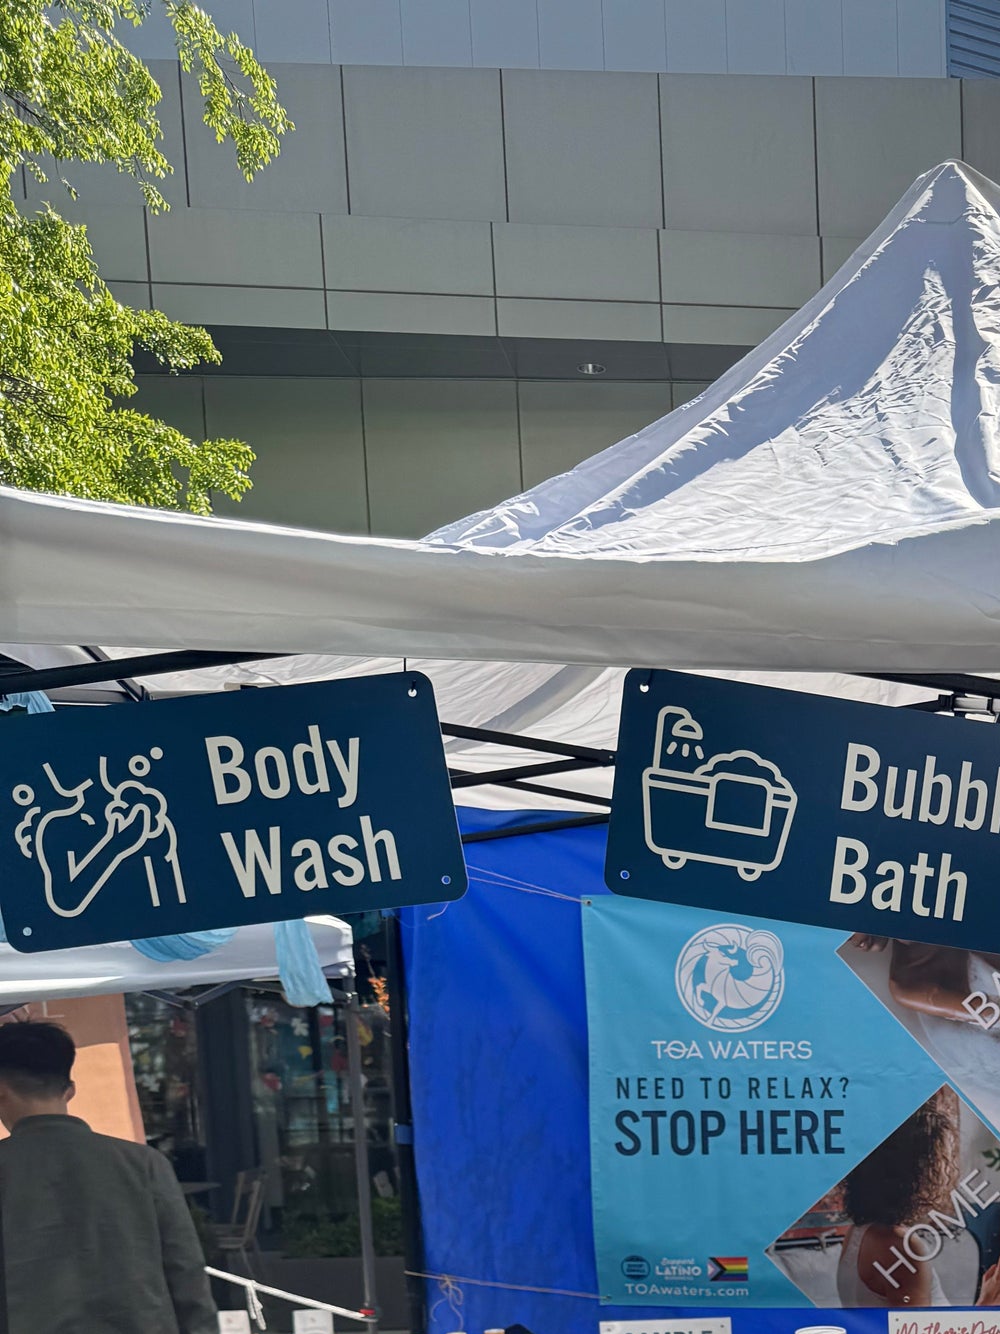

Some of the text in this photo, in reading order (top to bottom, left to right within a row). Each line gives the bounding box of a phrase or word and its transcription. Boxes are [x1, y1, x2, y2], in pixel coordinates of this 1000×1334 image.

[206, 725, 359, 807] Body
[221, 816, 402, 898] Wash
[830, 837, 968, 922] Bath
[651, 1041, 812, 1060] TOA WATERS
[616, 1077, 850, 1099] NEED TO RELAX?
[615, 1110, 846, 1156] STOP HERE
[873, 1170, 1000, 1289] HOME
[625, 1283, 749, 1296] TOAwaters.com
